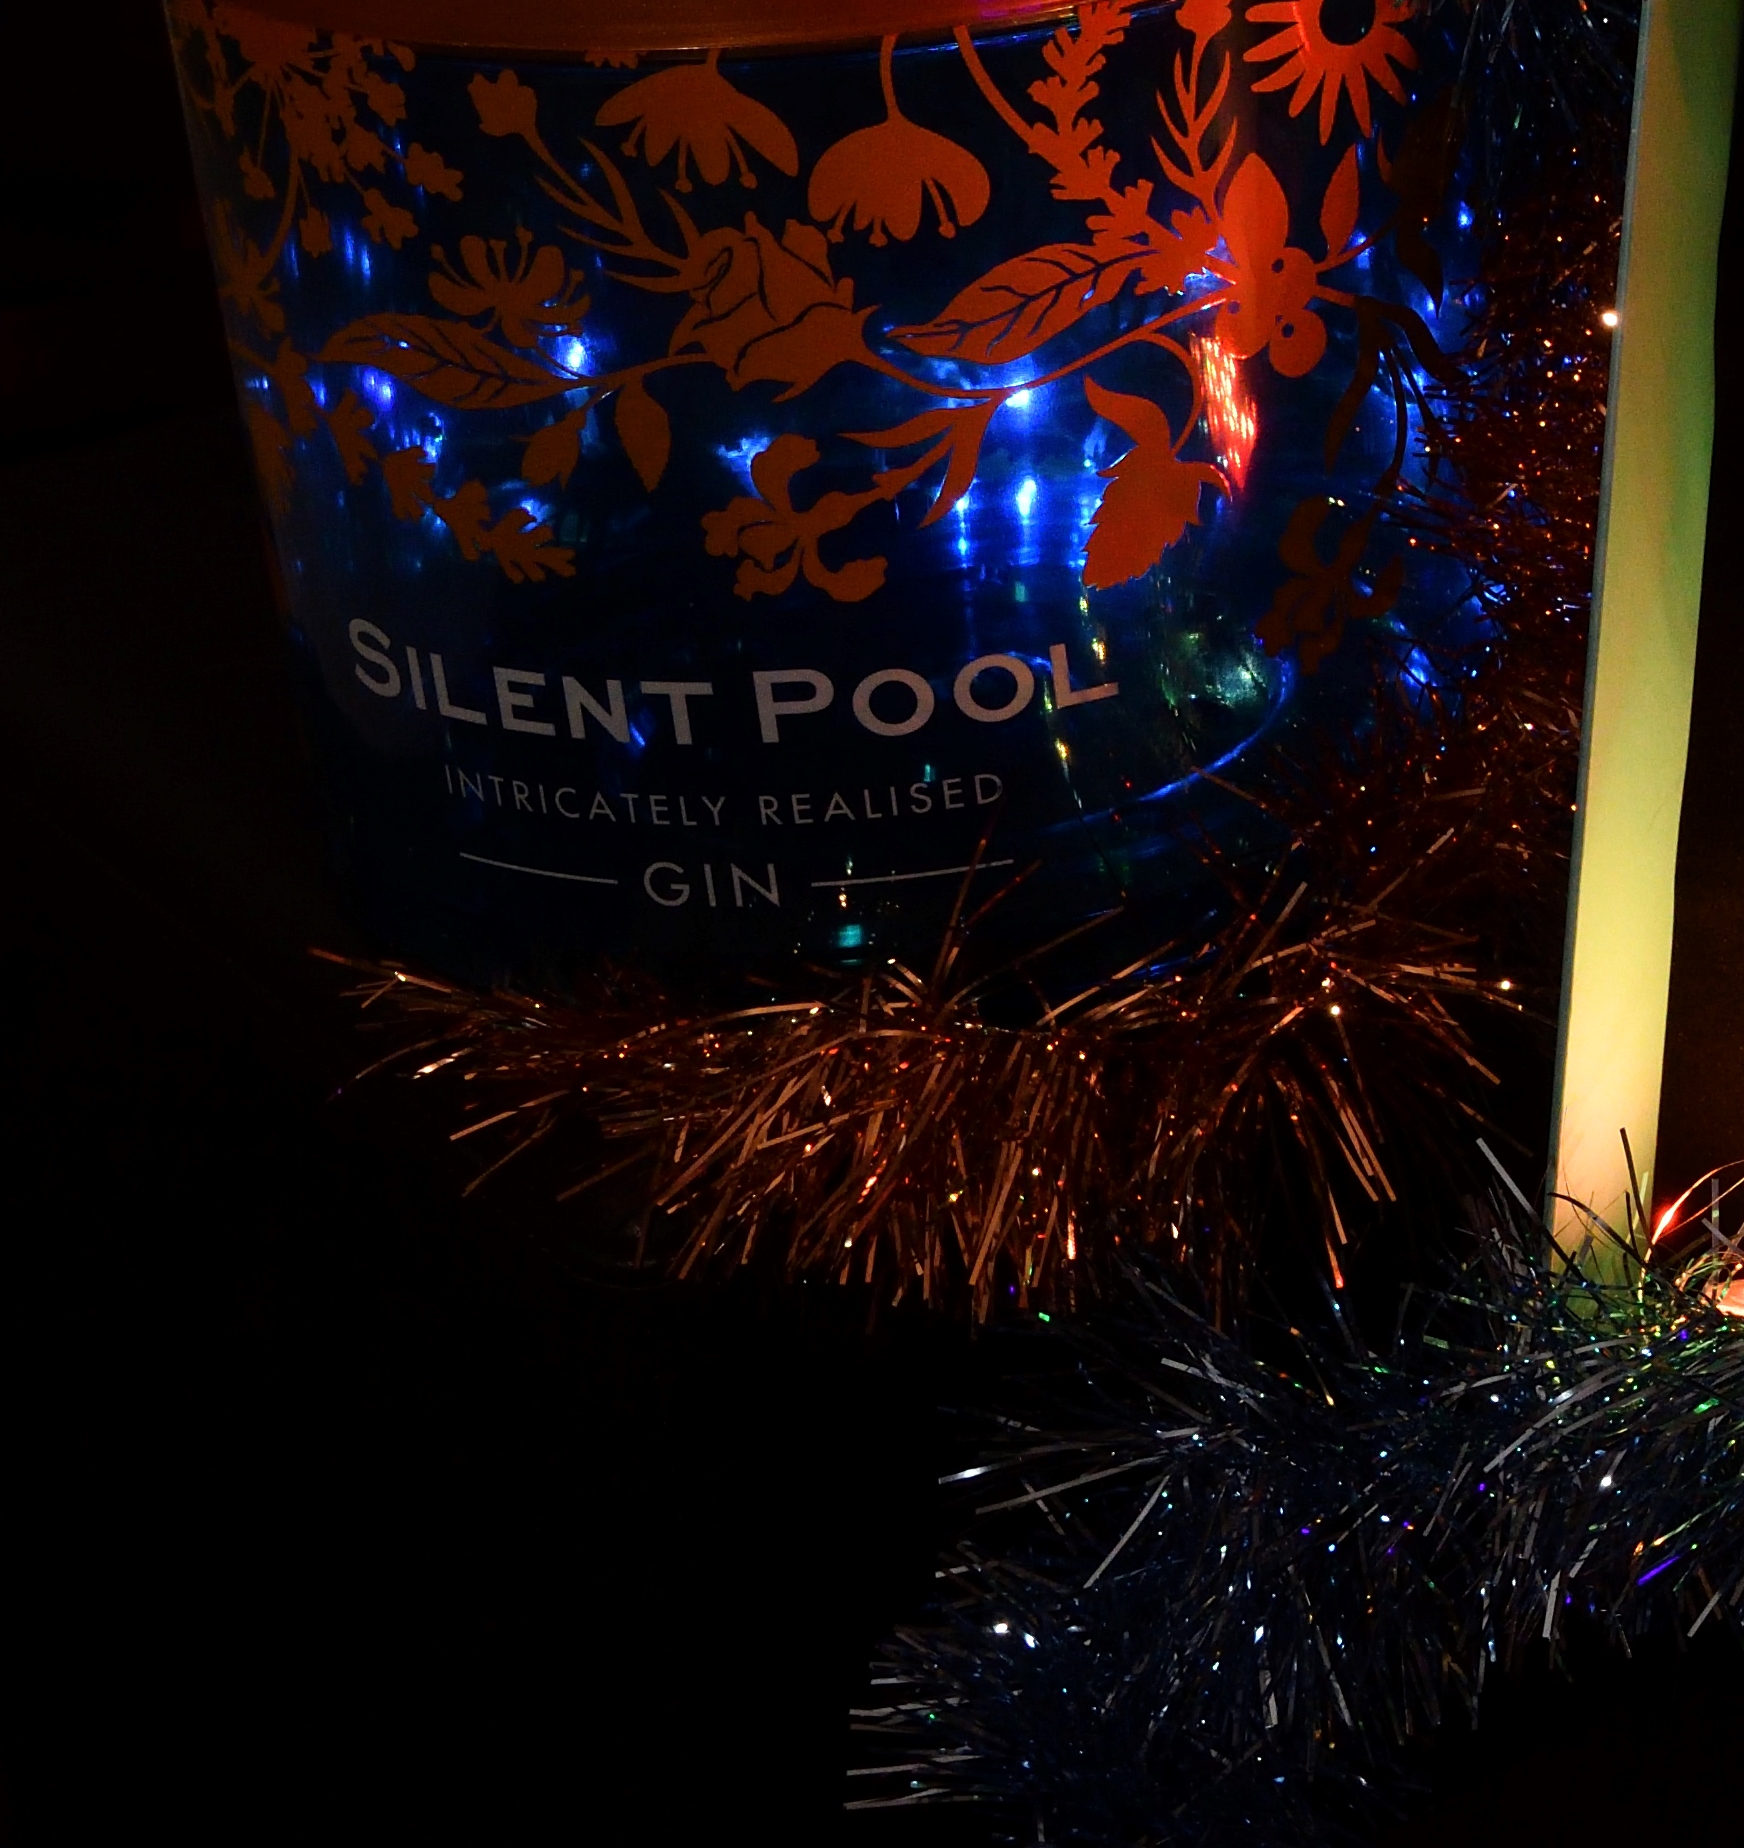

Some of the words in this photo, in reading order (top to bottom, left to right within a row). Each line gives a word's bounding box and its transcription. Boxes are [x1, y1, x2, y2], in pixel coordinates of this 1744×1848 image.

[348, 618, 714, 746] SILENT
[752, 643, 1120, 743] POOL
[445, 765, 728, 827] INTRICATELY
[760, 774, 1004, 826] REALISED
[643, 861, 780, 908] GIN
